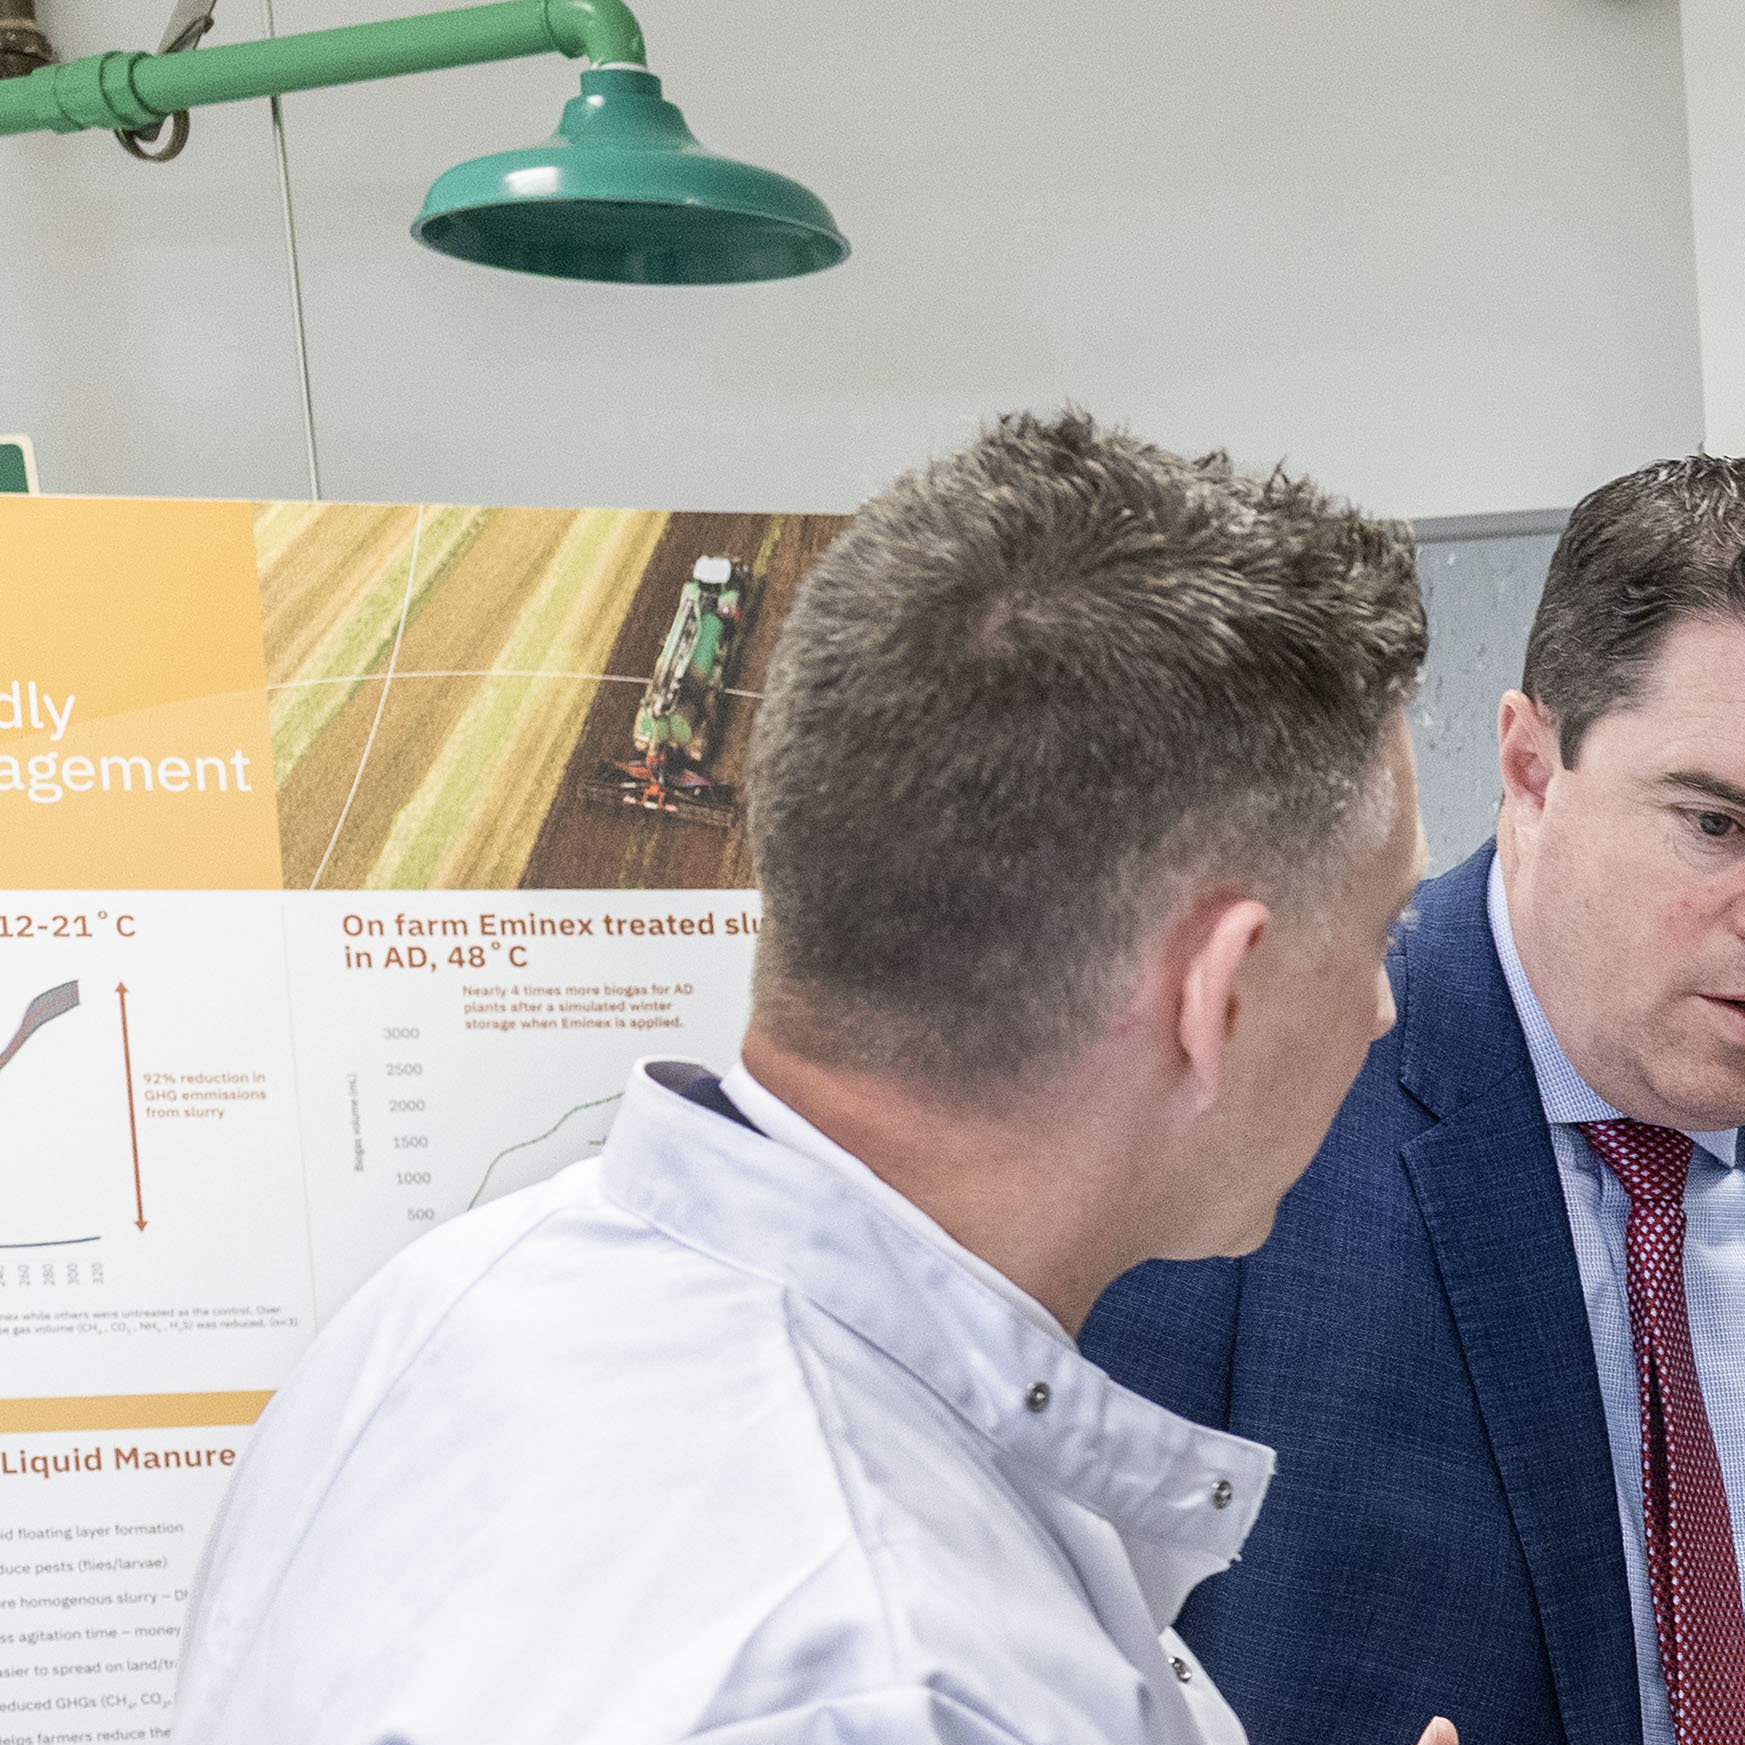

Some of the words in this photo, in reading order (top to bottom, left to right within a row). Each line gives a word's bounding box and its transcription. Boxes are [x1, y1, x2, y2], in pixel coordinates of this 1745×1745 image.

[0, 680, 75, 741] dly
[0, 749, 252, 804] agement
[342, 913, 385, 937] On
[397, 912, 469, 937] farm
[479, 912, 594, 937] Eminex
[603, 911, 715, 937] treated
[724, 911, 764, 936] slu
[345, 946, 372, 969] in
[384, 945, 438, 973] AD,
[463, 985, 506, 999] Nearly
[511, 985, 520, 996] 4
[524, 985, 561, 996] times
[565, 986, 600, 996] more
[604, 984, 648, 998] biogas
[652, 984, 670, 995] for
[674, 984, 694, 996] AD
[464, 1001, 506, 1015] plants
[511, 1001, 542, 1013] after
[546, 1003, 554, 1012] a
[558, 1000, 625, 1013] simulated
[631, 1001, 672, 1012] winter
[465, 1019, 515, 1032] storage
[520, 1018, 557, 1030] when
[561, 1018, 611, 1030] Eminex
[615, 1017, 626, 1029] is
[629, 1016, 684, 1031] applied.
[383, 1026, 421, 1041] 3000
[386, 1062, 423, 1077] 2500
[143, 1072, 176, 1085] 92%
[180, 1071, 249, 1084] reduction
[252, 1071, 266, 1083] in
[144, 1089, 177, 1102] GHG
[182, 1089, 267, 1101] emmissions
[146, 1106, 179, 1119] from
[184, 1106, 225, 1120] slurry
[389, 1099, 426, 1113] 2000
[393, 1136, 428, 1149] 1500
[396, 1172, 432, 1185] 1000
[407, 1208, 435, 1222] 500
[1, 1447, 103, 1479] Liquid
[114, 1446, 237, 1471] Manure
[18, 1526, 73, 1541] floating
[76, 1524, 110, 1539] layer
[114, 1522, 184, 1537] formation
[35, 1561, 74, 1576] pests
[20, 1594, 113, 1610] homogenous
[117, 1591, 158, 1605] slurry
[18, 1629, 81, 1646] agitation
[86, 1627, 118, 1640] time
[134, 1626, 182, 1639] money
[34, 1665, 49, 1677] to
[52, 1661, 101, 1678] spread
[105, 1662, 123, 1673] on
[56, 1695, 97, 1709] GHGs
[37, 1730, 92, 1745] farmers
[97, 1728, 146, 1742] reduce
[150, 1726, 172, 1739] the
